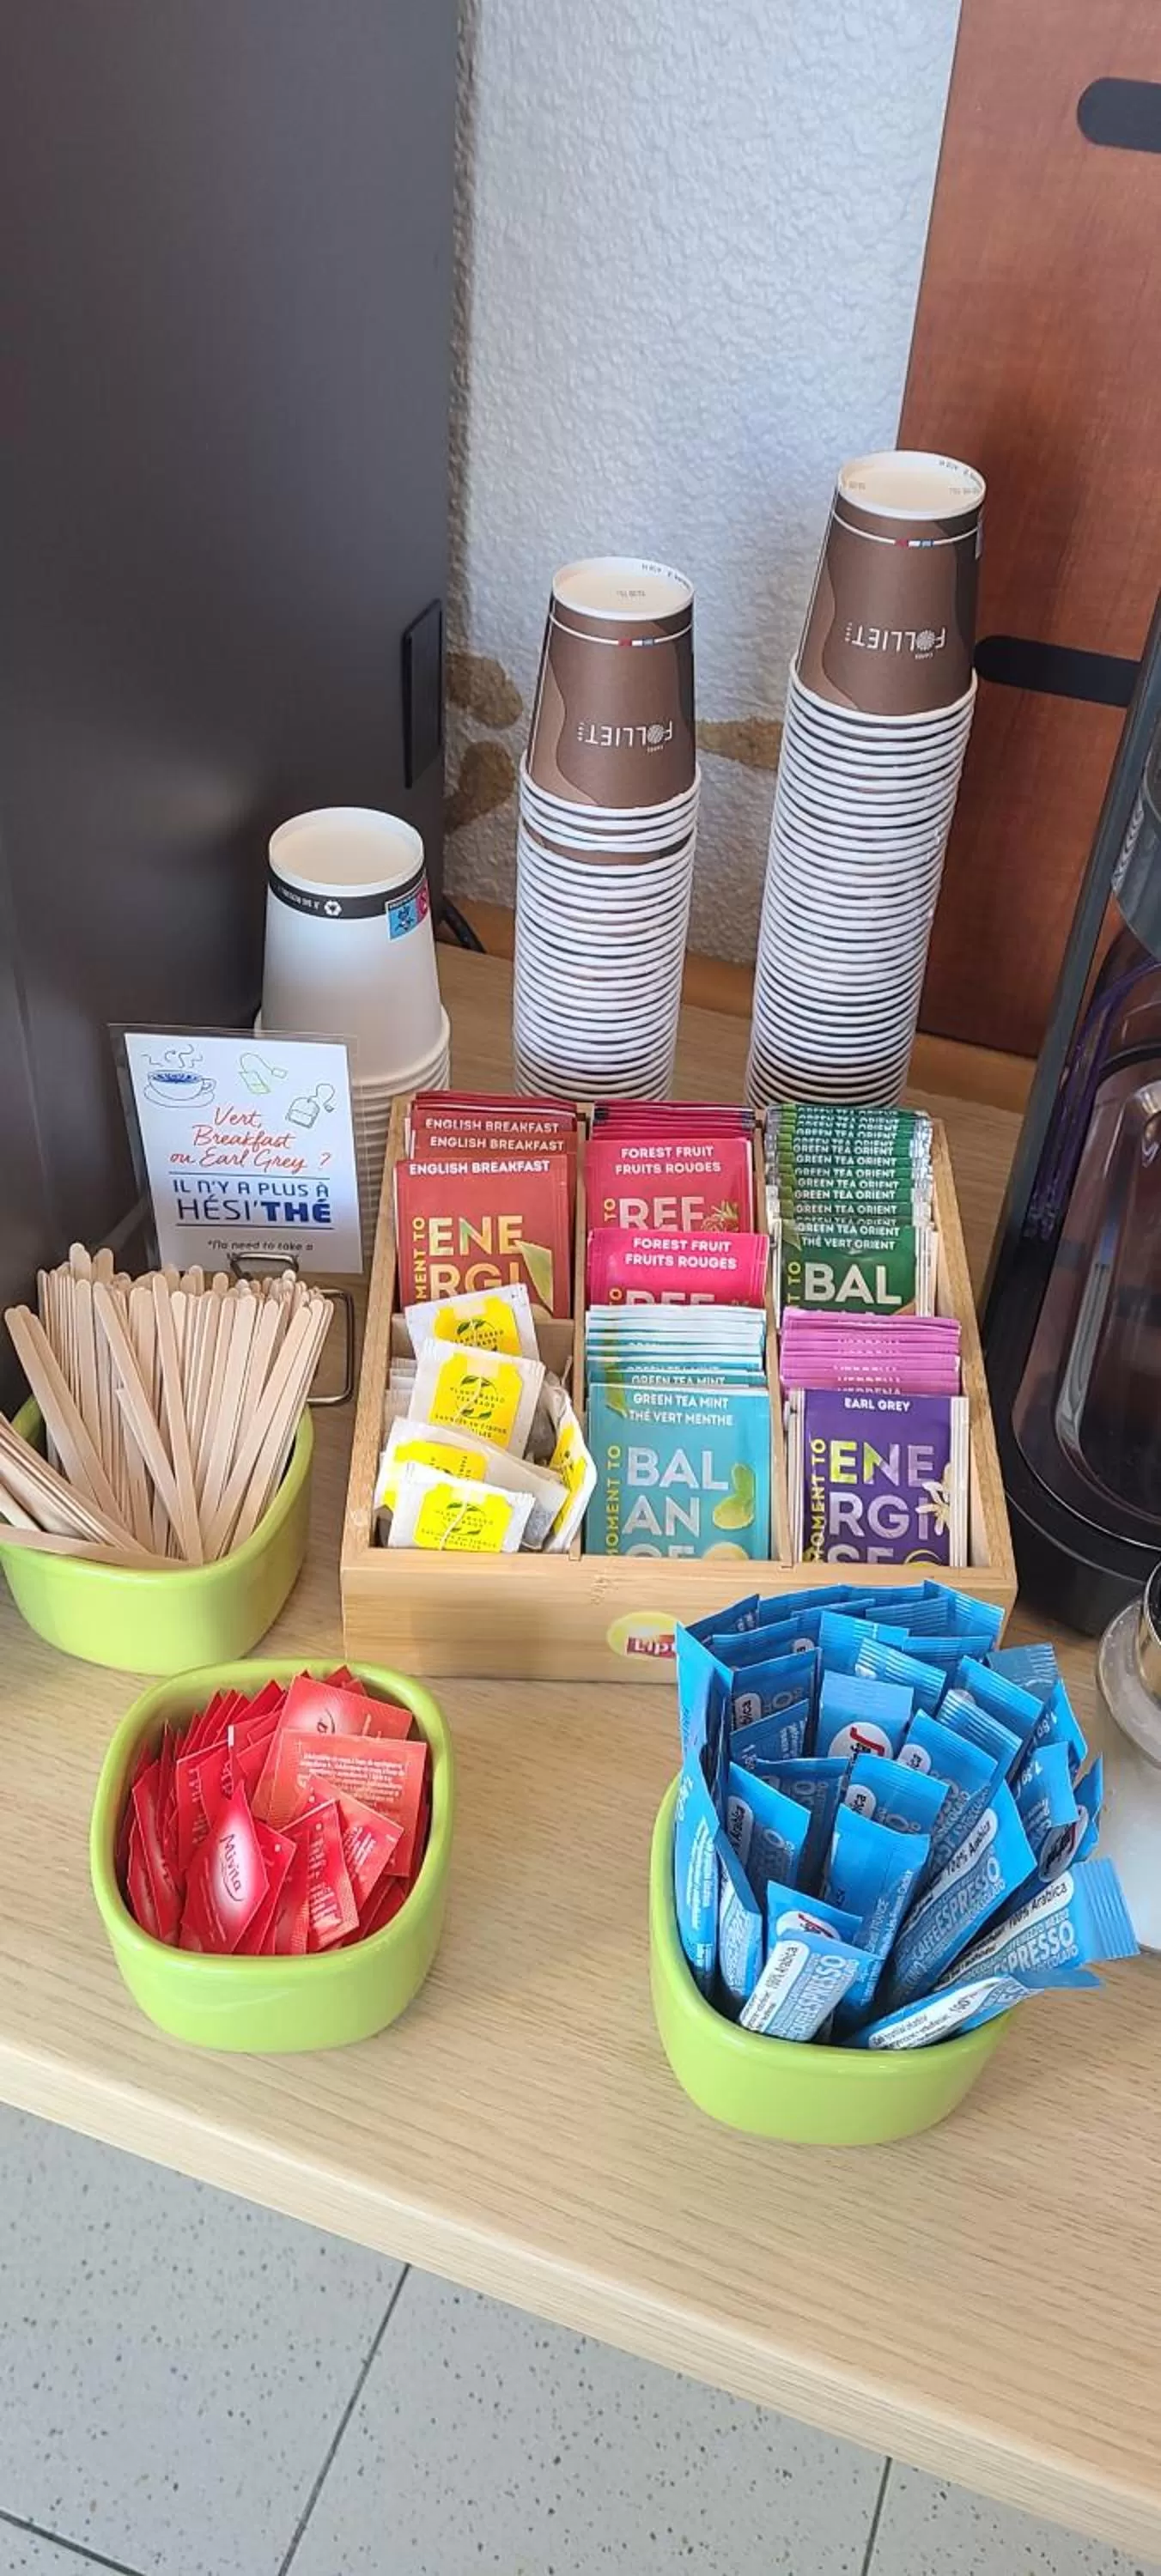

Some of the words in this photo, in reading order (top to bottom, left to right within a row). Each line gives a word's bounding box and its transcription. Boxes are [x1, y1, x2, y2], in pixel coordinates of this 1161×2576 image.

[850, 625, 946, 653] FOLLIET
[586, 720, 673, 746] FOLLIET
[216, 1106, 262, 1127] Vert,
[425, 1118, 482, 1132] ENGLISH
[485, 1119, 560, 1133] BREAKFAST
[192, 1124, 295, 1152] Breakfast
[429, 1136, 487, 1150] ENGLISH
[489, 1138, 565, 1152] BREAKFAST
[621, 1145, 672, 1159] FOREST
[675, 1145, 714, 1158] FRUIT
[170, 1152, 196, 1164] ou
[199, 1147, 250, 1168] Earl
[253, 1150, 308, 1174] Grey
[409, 1161, 469, 1176] ENGLISH
[471, 1160, 550, 1175] BREAKFAST
[615, 1161, 662, 1175] FRUITS
[665, 1159, 722, 1174] ROUGES
[796, 1155, 832, 1164] GREEN
[834, 1155, 854, 1165] TEA
[856, 1157, 897, 1167] ORIENT
[173, 1179, 191, 1194] IL
[238, 1182, 251, 1194] A
[258, 1182, 308, 1197] PLUS
[317, 1182, 329, 1198] À
[798, 1178, 834, 1188] GREEN
[836, 1179, 856, 1188] TEA
[859, 1180, 900, 1190] ORIENT
[794, 1189, 830, 1199] GREEN
[833, 1190, 854, 1200] TEA
[855, 1190, 896, 1200] ORIENT
[796, 1205, 832, 1213] GREEN
[835, 1205, 854, 1214] TEA
[856, 1205, 897, 1215] ORIENT
[429, 1215, 523, 1256] ENE
[797, 1222, 834, 1233] GREEN
[836, 1224, 857, 1235] TEA
[860, 1225, 901, 1236] ORIENT
[231, 1240, 258, 1250] need
[263, 1241, 276, 1250] to
[277, 1240, 301, 1250] take
[633, 1237, 689, 1251] FOREST
[691, 1240, 732, 1253] FRUIT
[824, 1237, 852, 1249] VERT
[854, 1239, 896, 1250] ORIENT
[625, 1253, 674, 1267] FRUITS
[678, 1255, 738, 1270] ROUGES
[804, 1261, 903, 1305] BAL
[634, 1393, 672, 1406] GREEN
[675, 1394, 698, 1407] TEA
[700, 1396, 729, 1409] MINT
[844, 1397, 875, 1410] EARL
[878, 1400, 910, 1413] GREY
[652, 1412, 684, 1425] VERT
[686, 1413, 734, 1426] MENTHE
[627, 1446, 729, 1491] BAL
[830, 1439, 936, 1488] ENE
[621, 1495, 701, 1538] AN
[1031, 1882, 1067, 1911] Arabica
